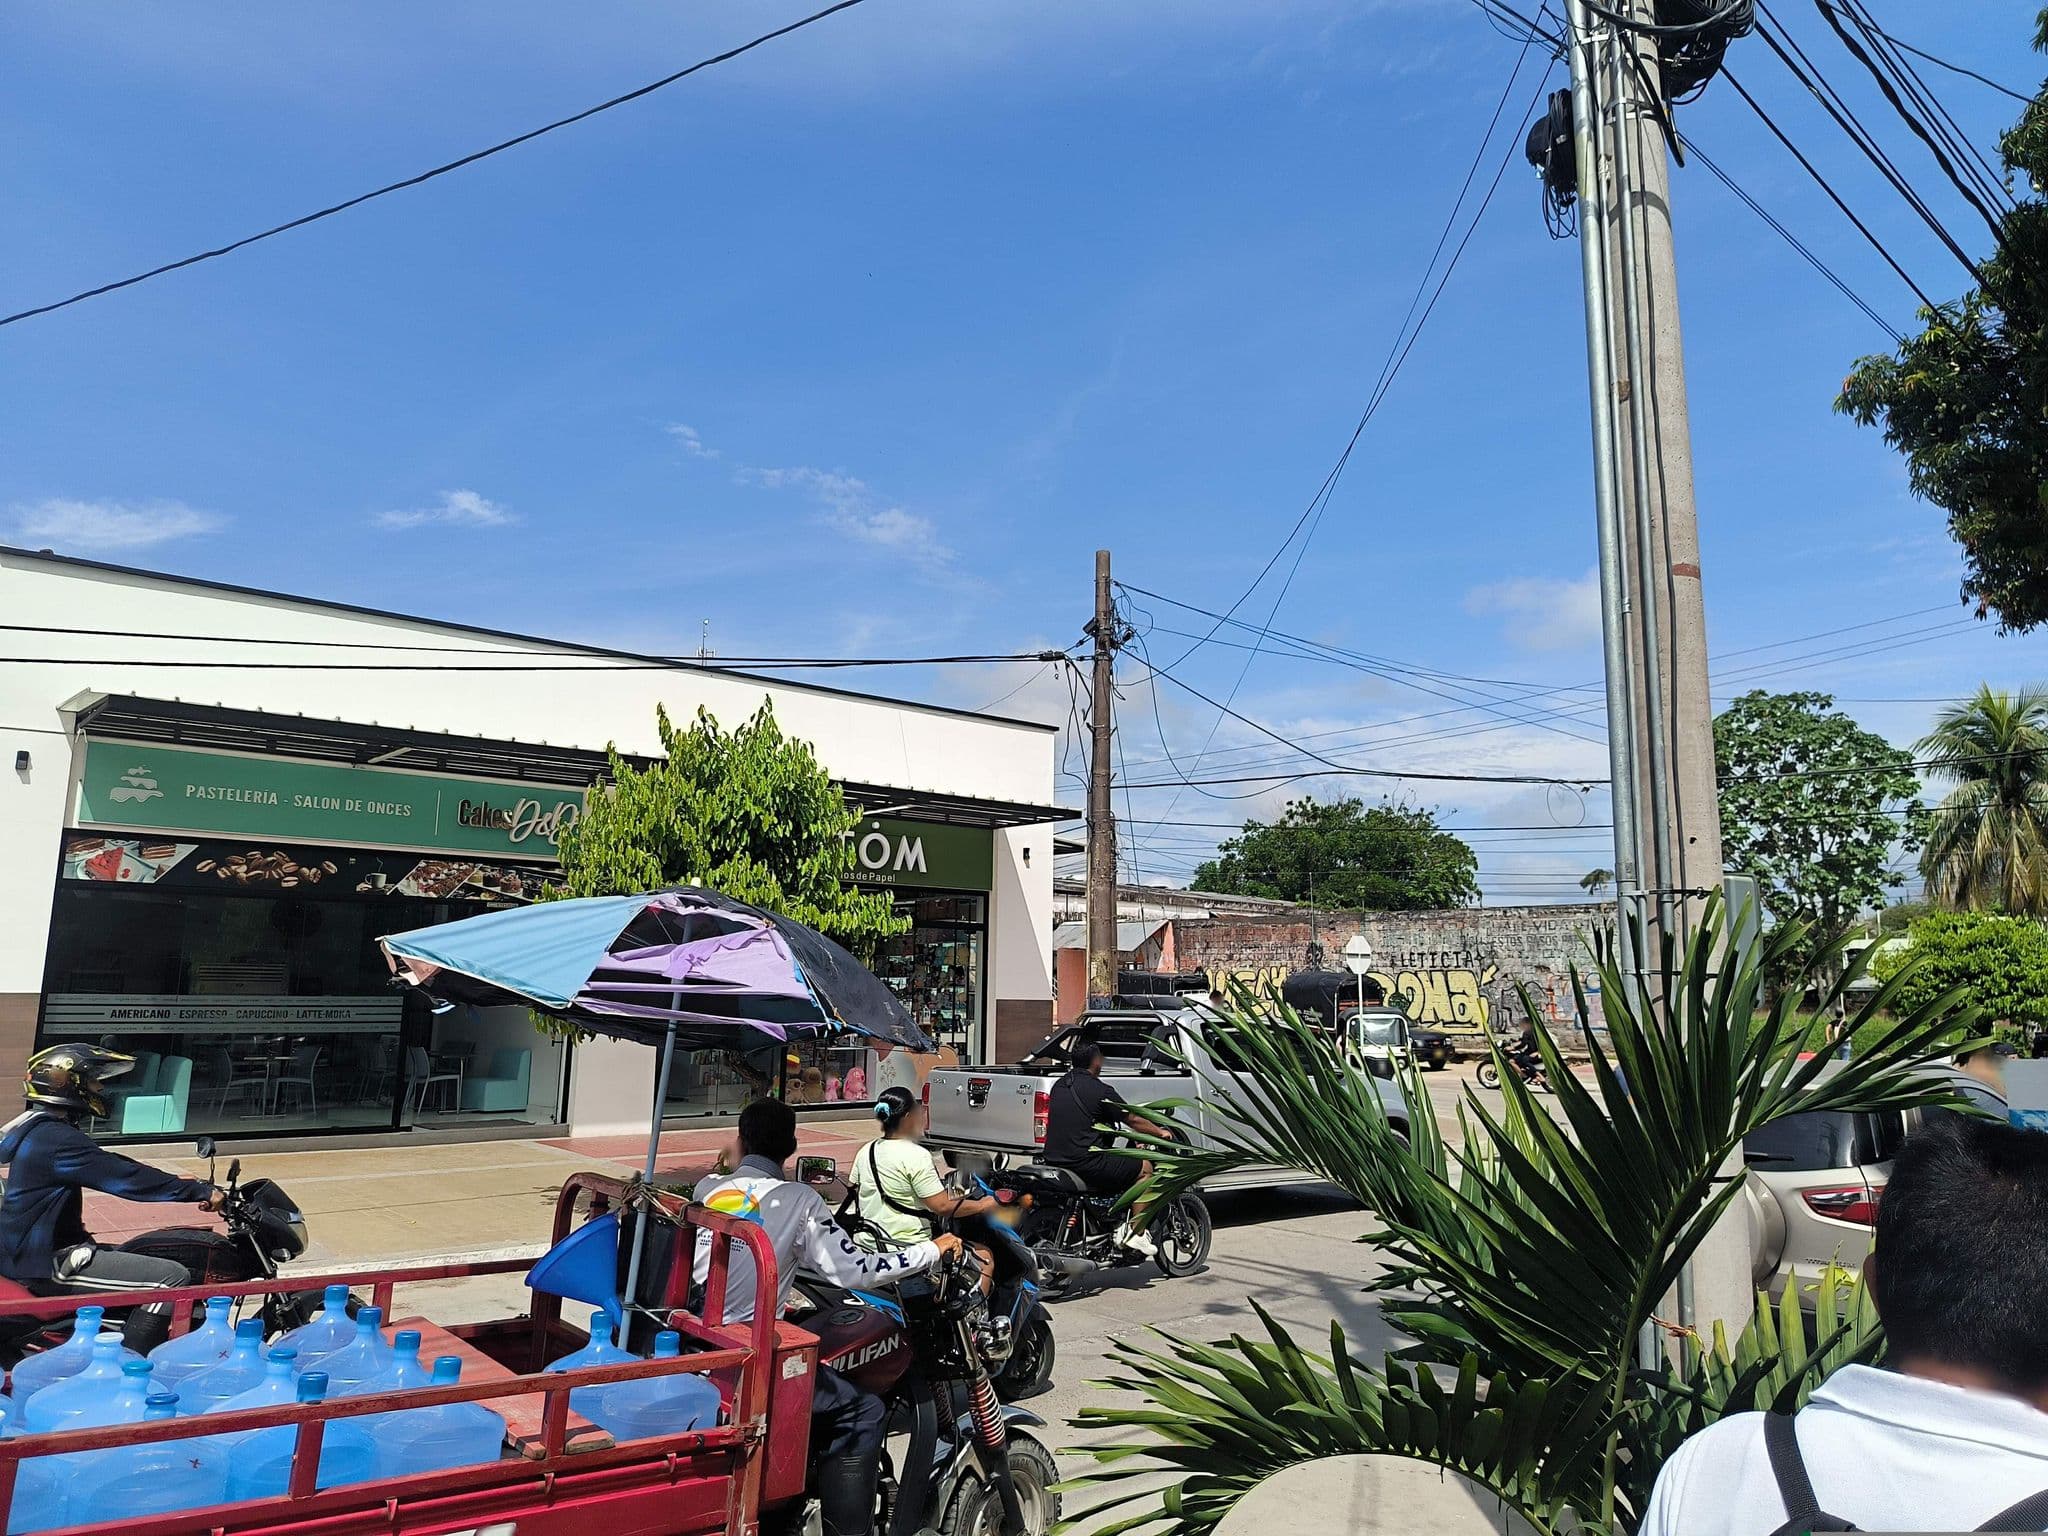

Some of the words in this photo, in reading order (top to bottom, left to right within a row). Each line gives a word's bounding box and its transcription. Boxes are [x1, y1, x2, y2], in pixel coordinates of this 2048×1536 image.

[185, 784, 278, 805] PASTELERÍA
[294, 794, 340, 810] SALON
[345, 800, 362, 812] DE
[367, 801, 412, 817] ONCES
[458, 799, 514, 830] Cakes
[869, 872, 896, 884] Papel
[110, 1009, 170, 1019] AMERICANO
[179, 1009, 228, 1019] ESPRESSO
[236, 1009, 288, 1019] CAPUCCINO
[847, 1332, 900, 1370] LIFAN
